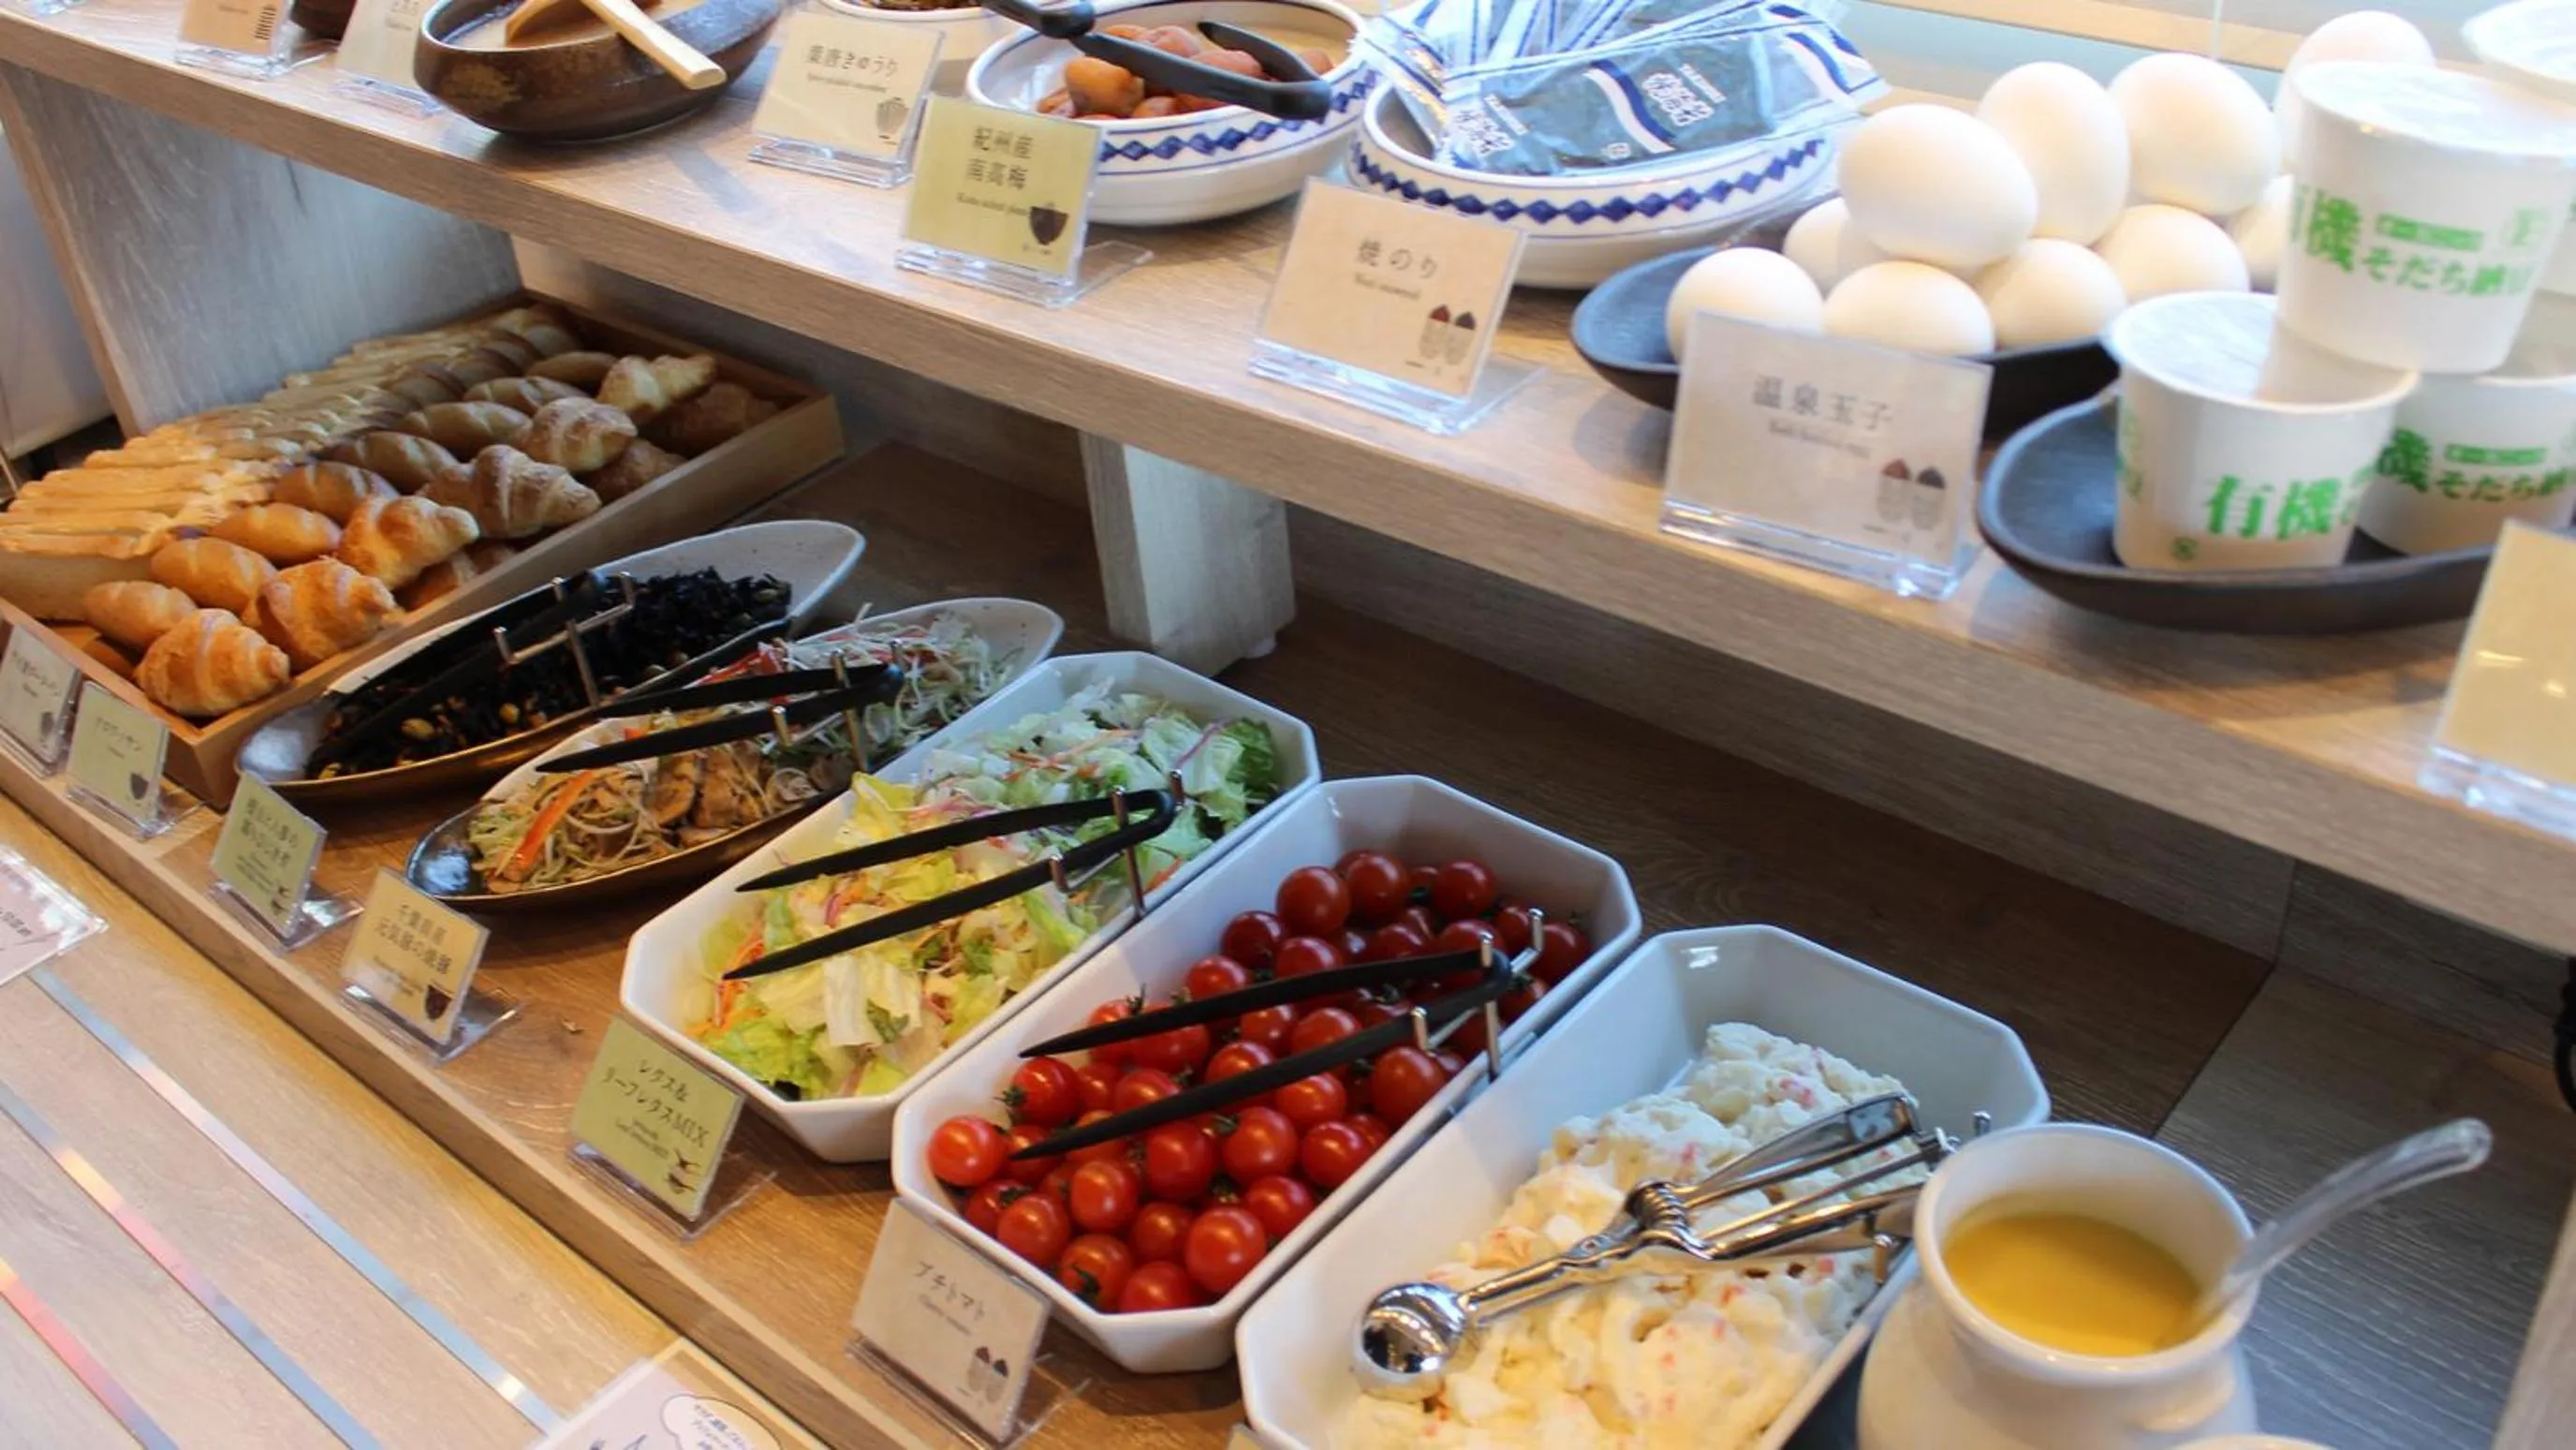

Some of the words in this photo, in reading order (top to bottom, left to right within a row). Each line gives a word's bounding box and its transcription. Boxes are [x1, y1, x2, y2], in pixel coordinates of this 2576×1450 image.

[1358, 239, 1438, 279] 焼のり
[1752, 376, 1892, 431] 温泉玉子
[2204, 473, 2341, 540] 有機
[914, 1261, 986, 1321] プチトマト
